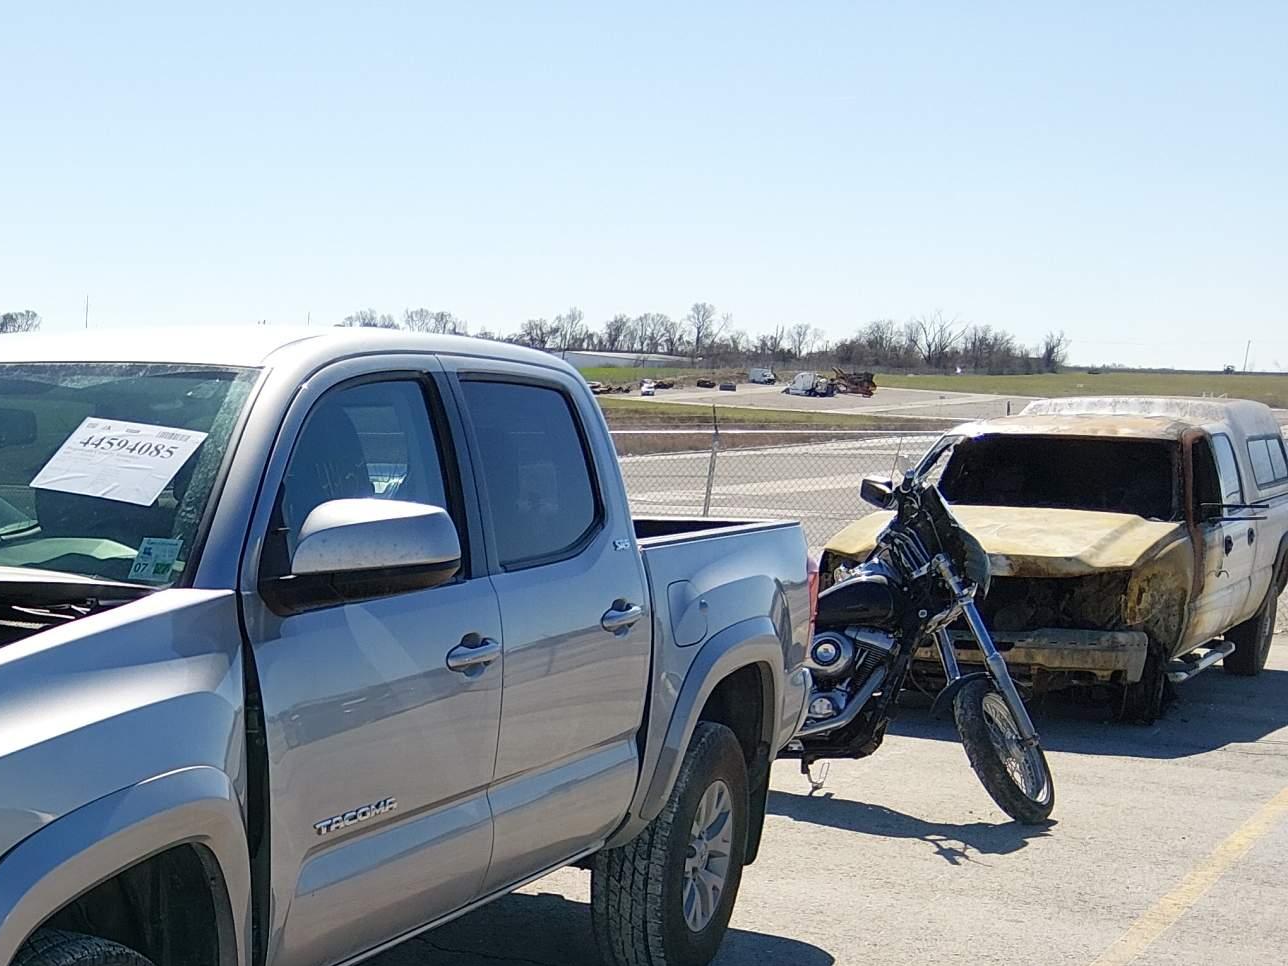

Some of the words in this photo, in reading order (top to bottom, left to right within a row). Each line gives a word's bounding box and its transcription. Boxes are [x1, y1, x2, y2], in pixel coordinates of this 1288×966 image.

[79, 434, 180, 460] 44594085
[133, 562, 149, 573] 07
[313, 797, 398, 835] TACOMA
